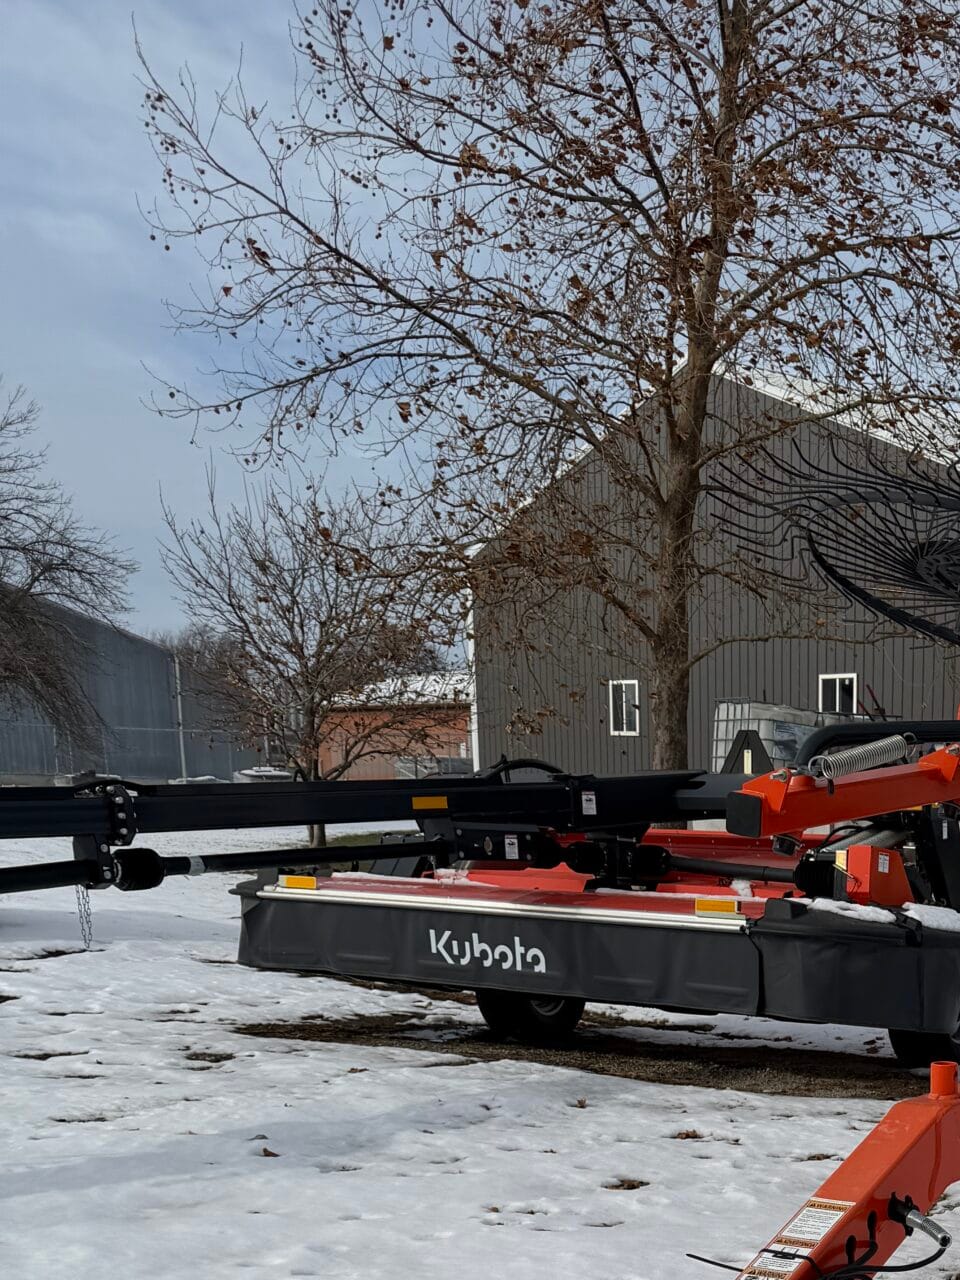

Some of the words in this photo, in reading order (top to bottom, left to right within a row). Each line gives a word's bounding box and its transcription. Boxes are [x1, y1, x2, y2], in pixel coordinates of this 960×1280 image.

[429, 928, 546, 974] Kubota
[816, 1203, 848, 1211] WARNING
[756, 1269, 788, 1280] WARNING
